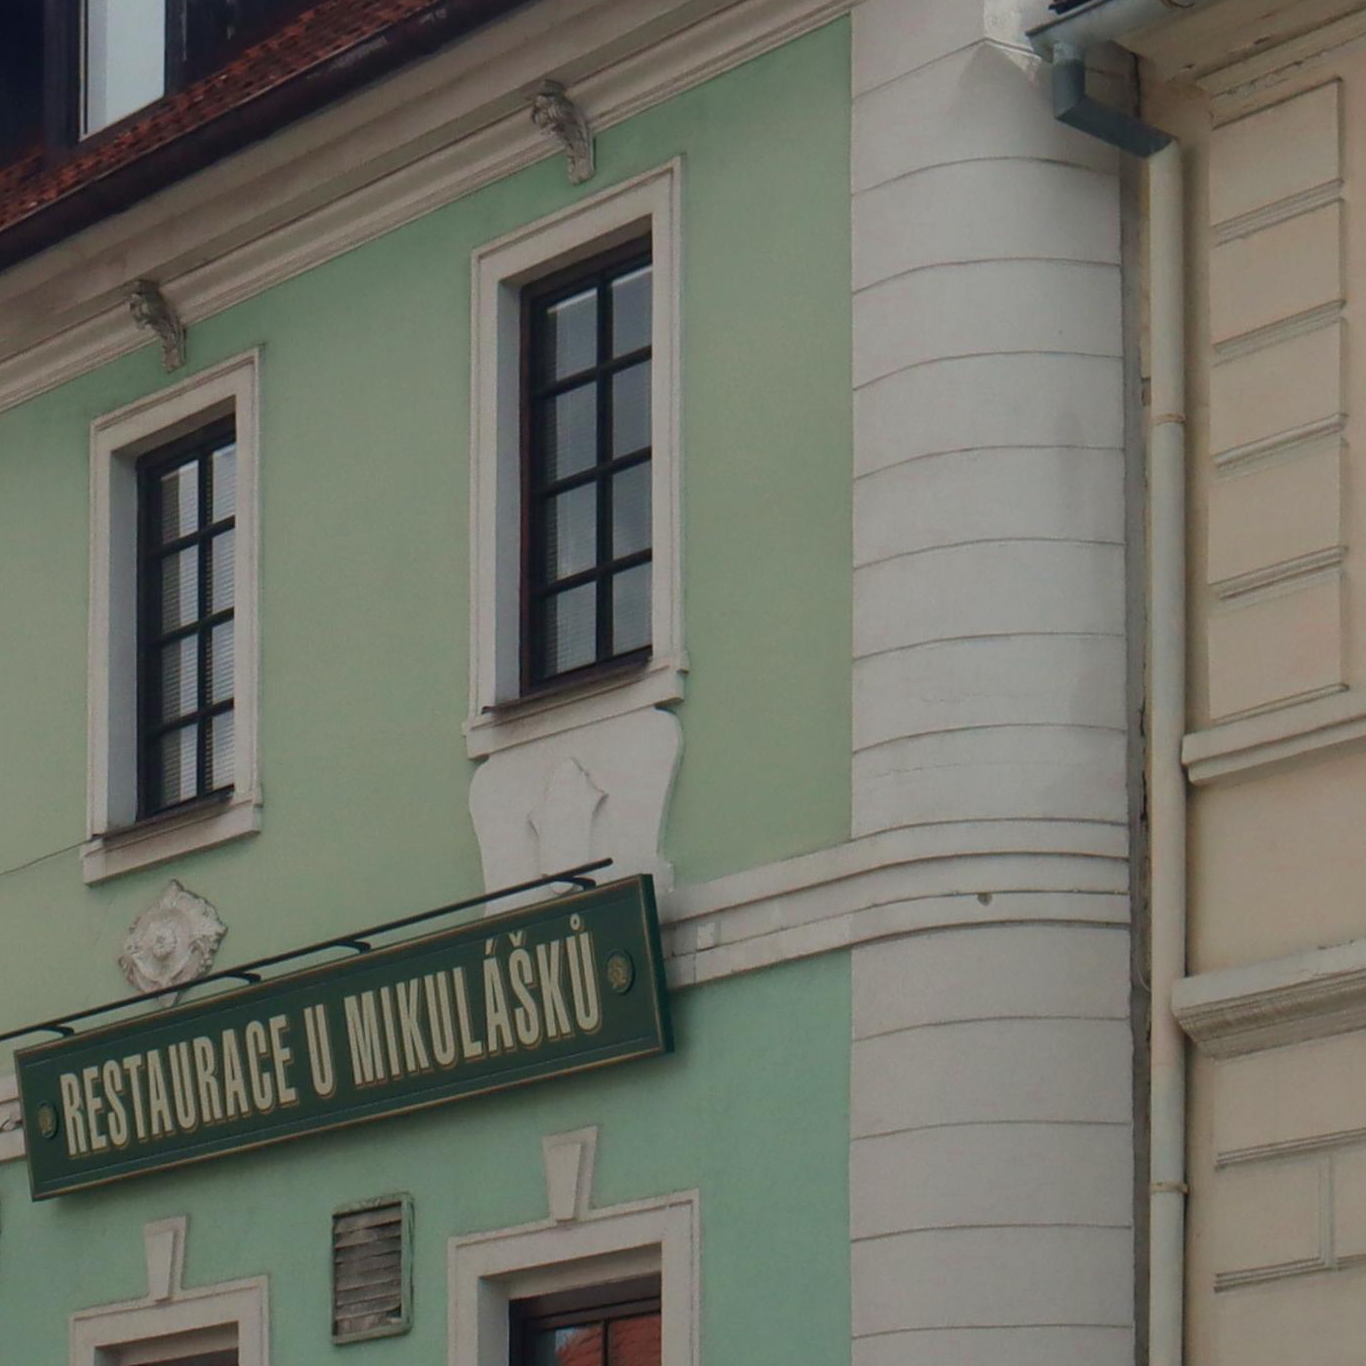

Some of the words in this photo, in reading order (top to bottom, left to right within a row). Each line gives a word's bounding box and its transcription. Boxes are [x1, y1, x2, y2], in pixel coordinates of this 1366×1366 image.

[60, 1014, 298, 1158] RESTAURACE
[304, 1003, 335, 1098] U
[344, 913, 602, 1087] MIKULÁŠKŮ
